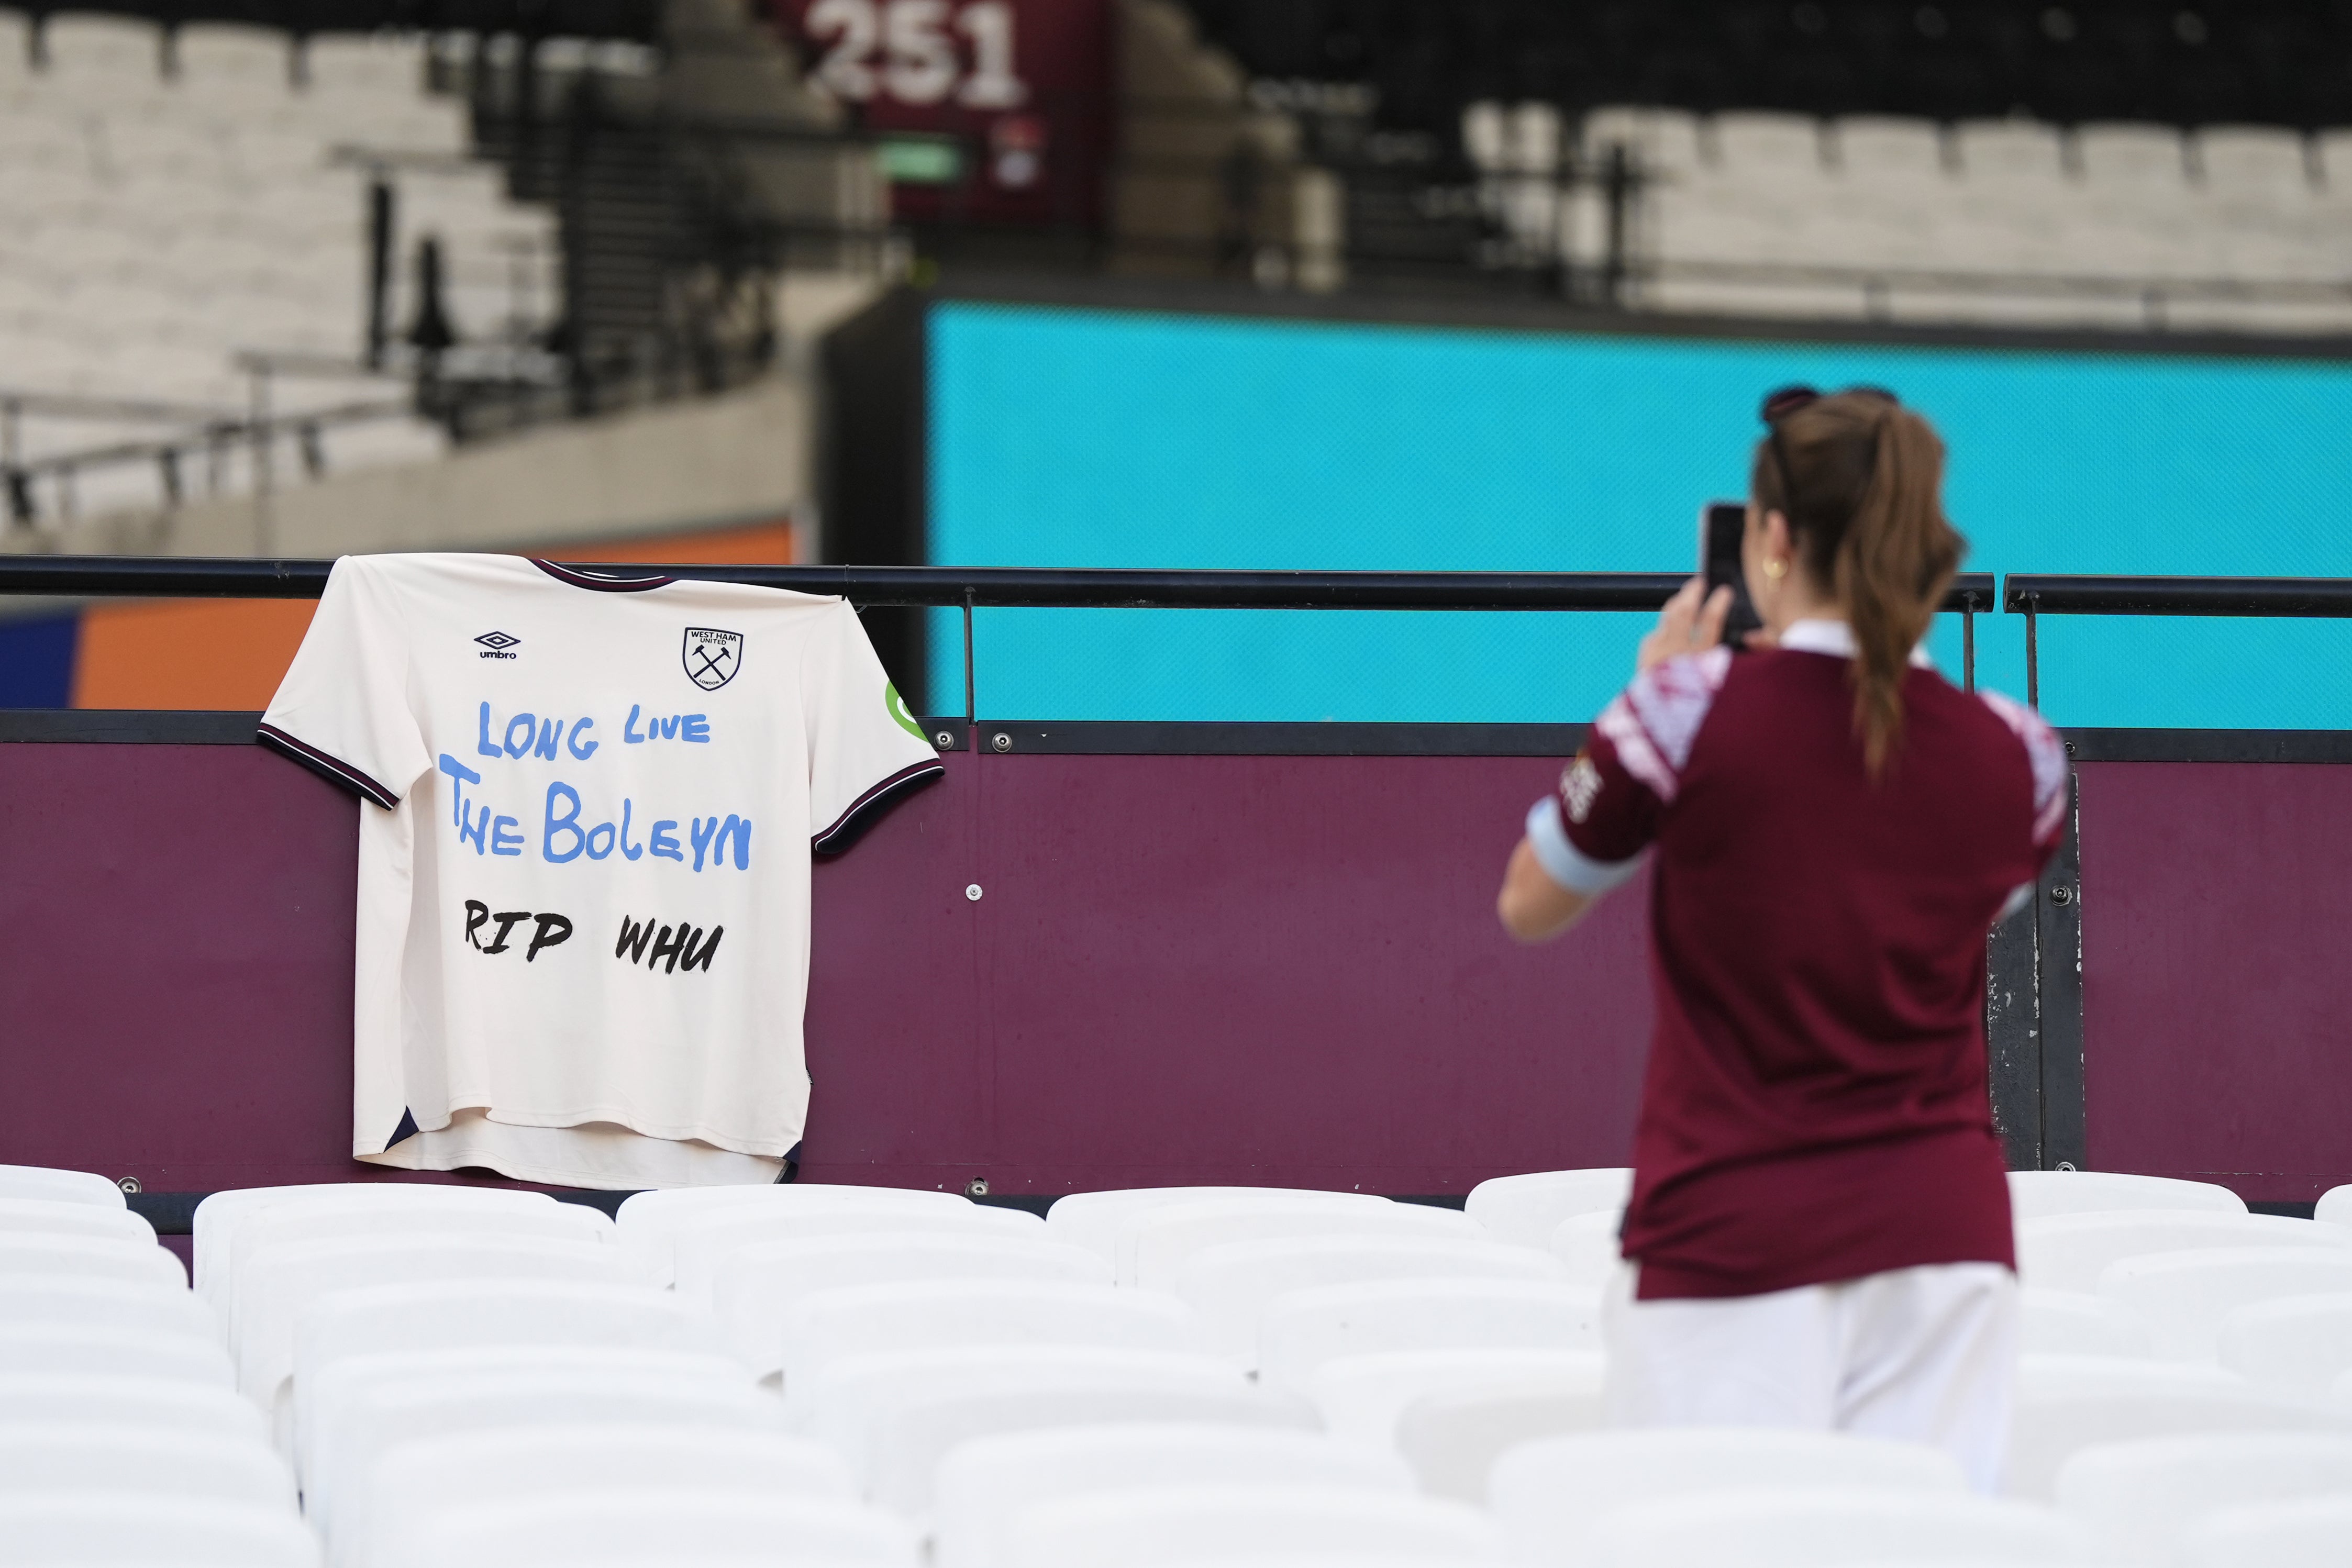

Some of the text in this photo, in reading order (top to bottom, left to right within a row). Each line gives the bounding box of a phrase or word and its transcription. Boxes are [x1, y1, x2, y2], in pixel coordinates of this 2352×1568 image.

[804, 0, 1029, 108] 251
[480, 650, 517, 659] umbro
[716, 632, 736, 642] HAM
[478, 701, 710, 761] LONG LIVE
[464, 899, 724, 975] RIP WHU
